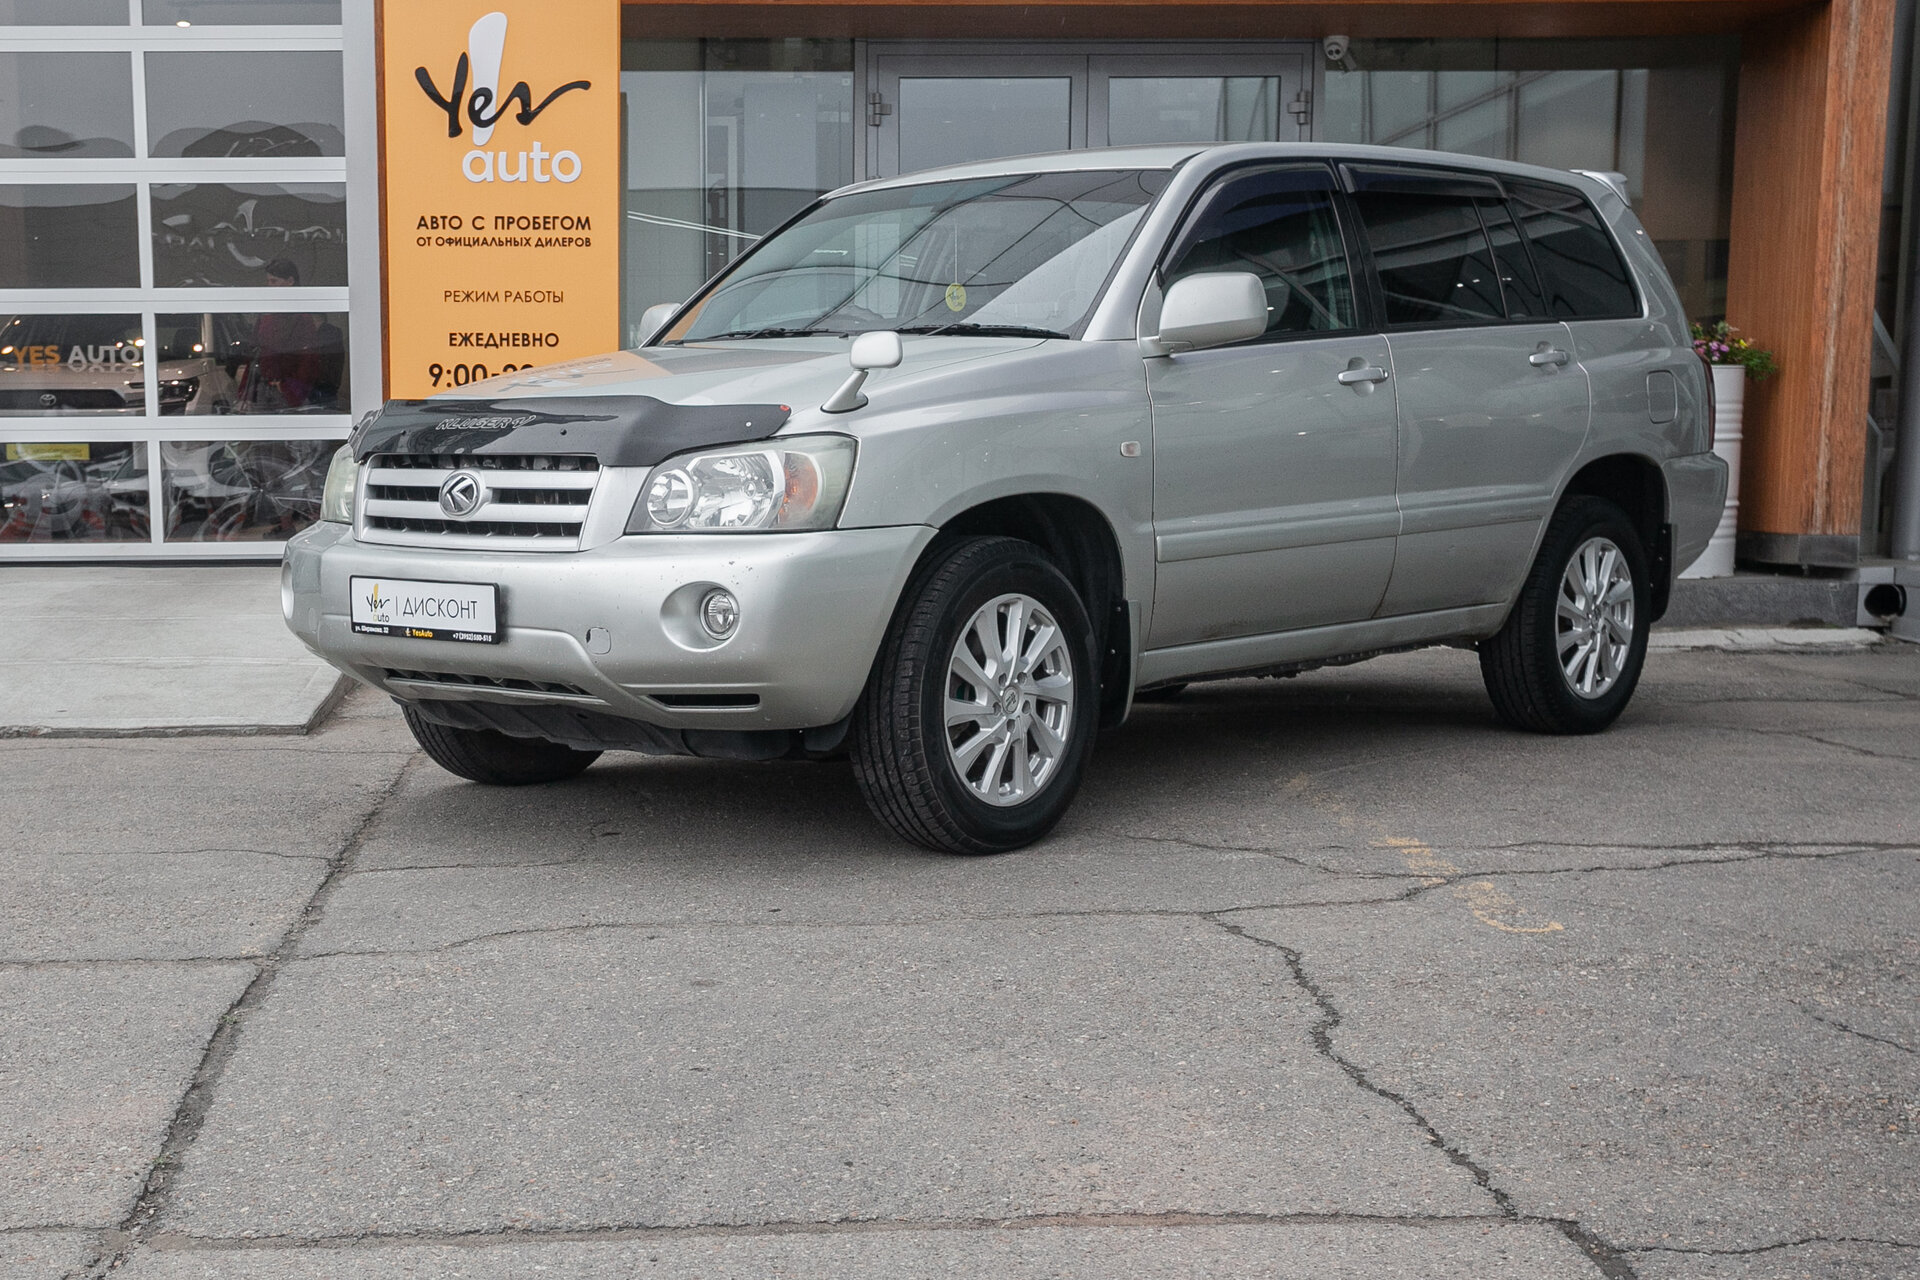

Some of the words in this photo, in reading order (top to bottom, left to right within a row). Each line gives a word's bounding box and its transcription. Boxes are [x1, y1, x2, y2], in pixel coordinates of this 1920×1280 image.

[414, 51, 592, 138] Yes
[462, 140, 583, 183] auto
[416, 215, 463, 230] АВТО
[471, 215, 485, 230] С
[494, 215, 592, 231] ПРОБЕГОМ
[416, 236, 432, 247] ОТ
[435, 236, 532, 249] ОФИЦИАЛЬНЫХ
[534, 237, 592, 249] ДИЛЕРОВ
[443, 290, 500, 303] РЕЖИМ
[504, 290, 564, 304] РАБОТЫ
[448, 332, 560, 349] ЕЖЕДНЕВНО
[13, 345, 61, 365] YES
[67, 344, 141, 364] AUTO
[435, 416, 513, 431] KLUGER
[402, 596, 478, 620] ДИСКОНТ
[372, 613, 390, 623] auto
